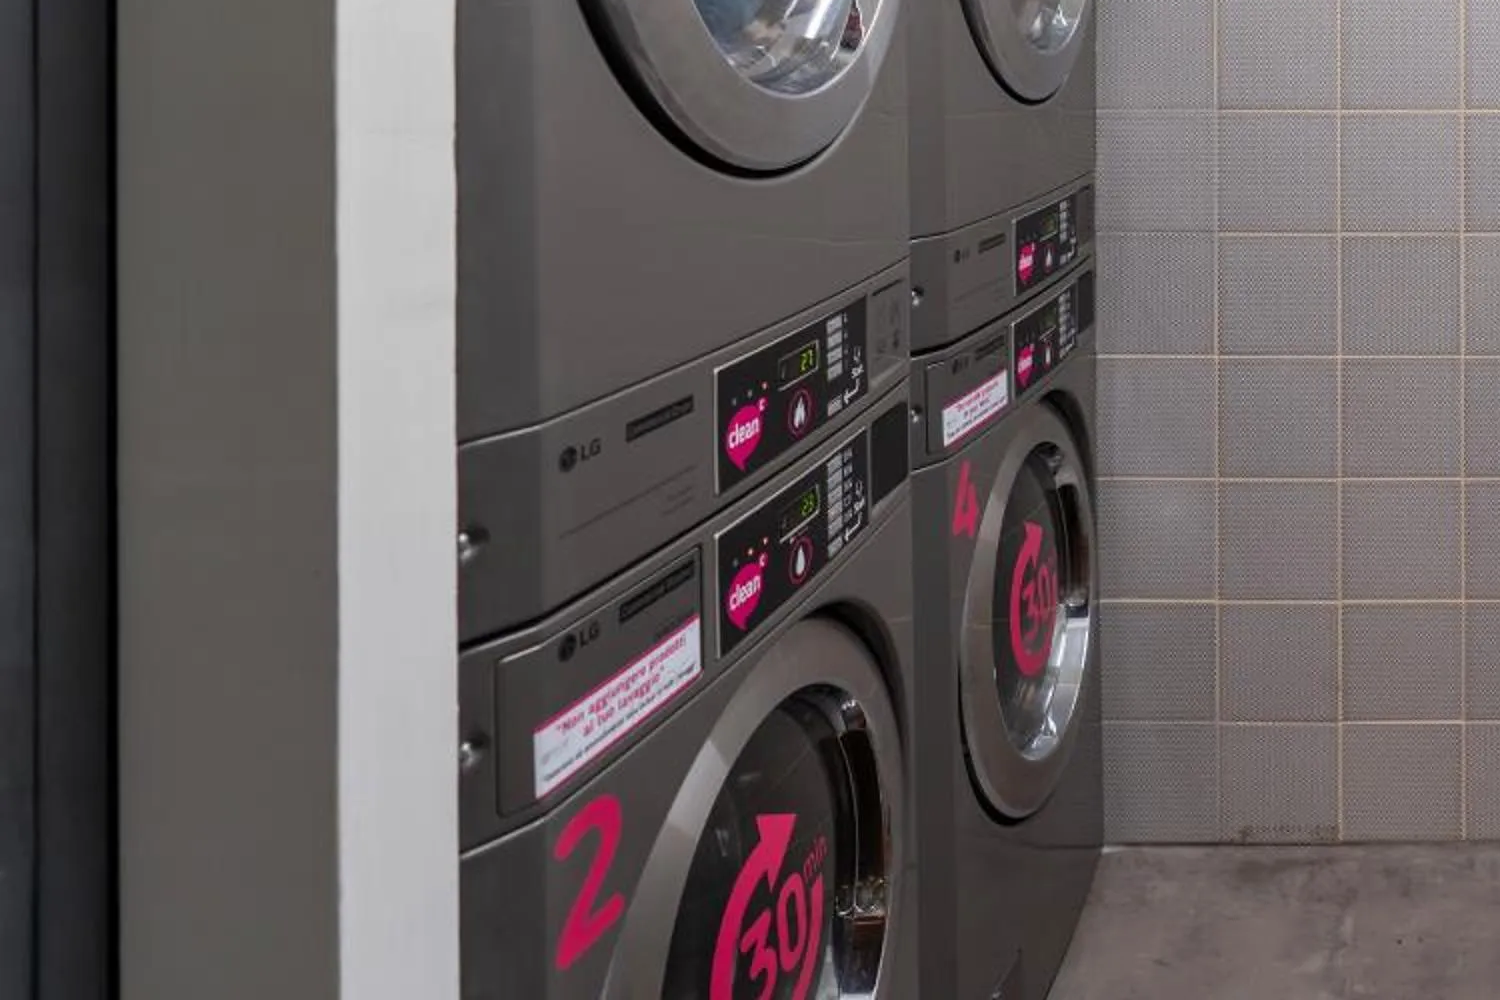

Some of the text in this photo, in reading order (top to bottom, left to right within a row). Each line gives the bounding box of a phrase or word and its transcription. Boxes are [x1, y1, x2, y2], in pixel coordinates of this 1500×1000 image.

[580, 437, 602, 462] LG
[728, 416, 760, 450] clean
[953, 459, 979, 537] 4
[728, 575, 762, 611] clean
[1023, 565, 1050, 642] 30
[579, 621, 600, 647] LG
[553, 793, 625, 970] 2
[740, 872, 807, 1000] 30
